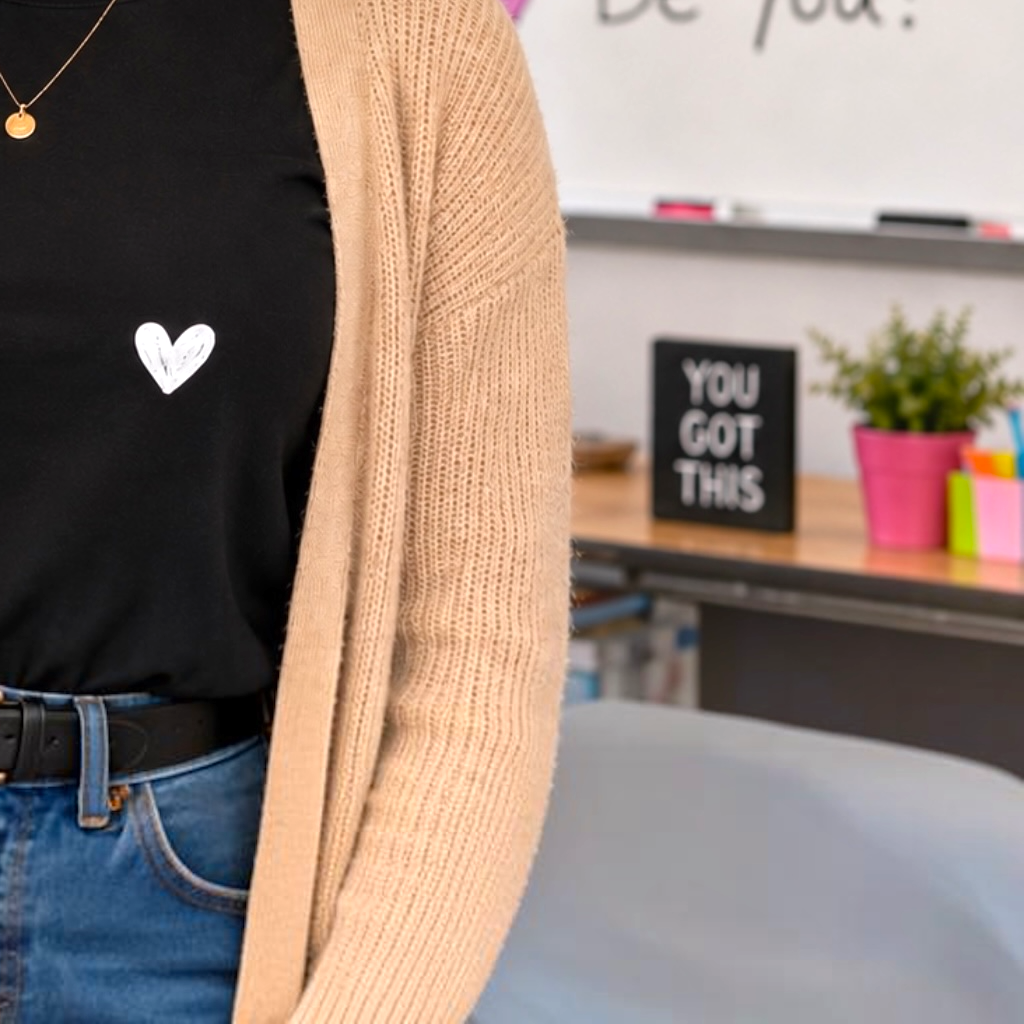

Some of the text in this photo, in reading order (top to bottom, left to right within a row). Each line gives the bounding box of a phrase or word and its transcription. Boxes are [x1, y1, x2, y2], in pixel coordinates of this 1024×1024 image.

[680, 357, 761, 410] YOU
[679, 408, 764, 462] GOT
[672, 458, 766, 513] THIS
